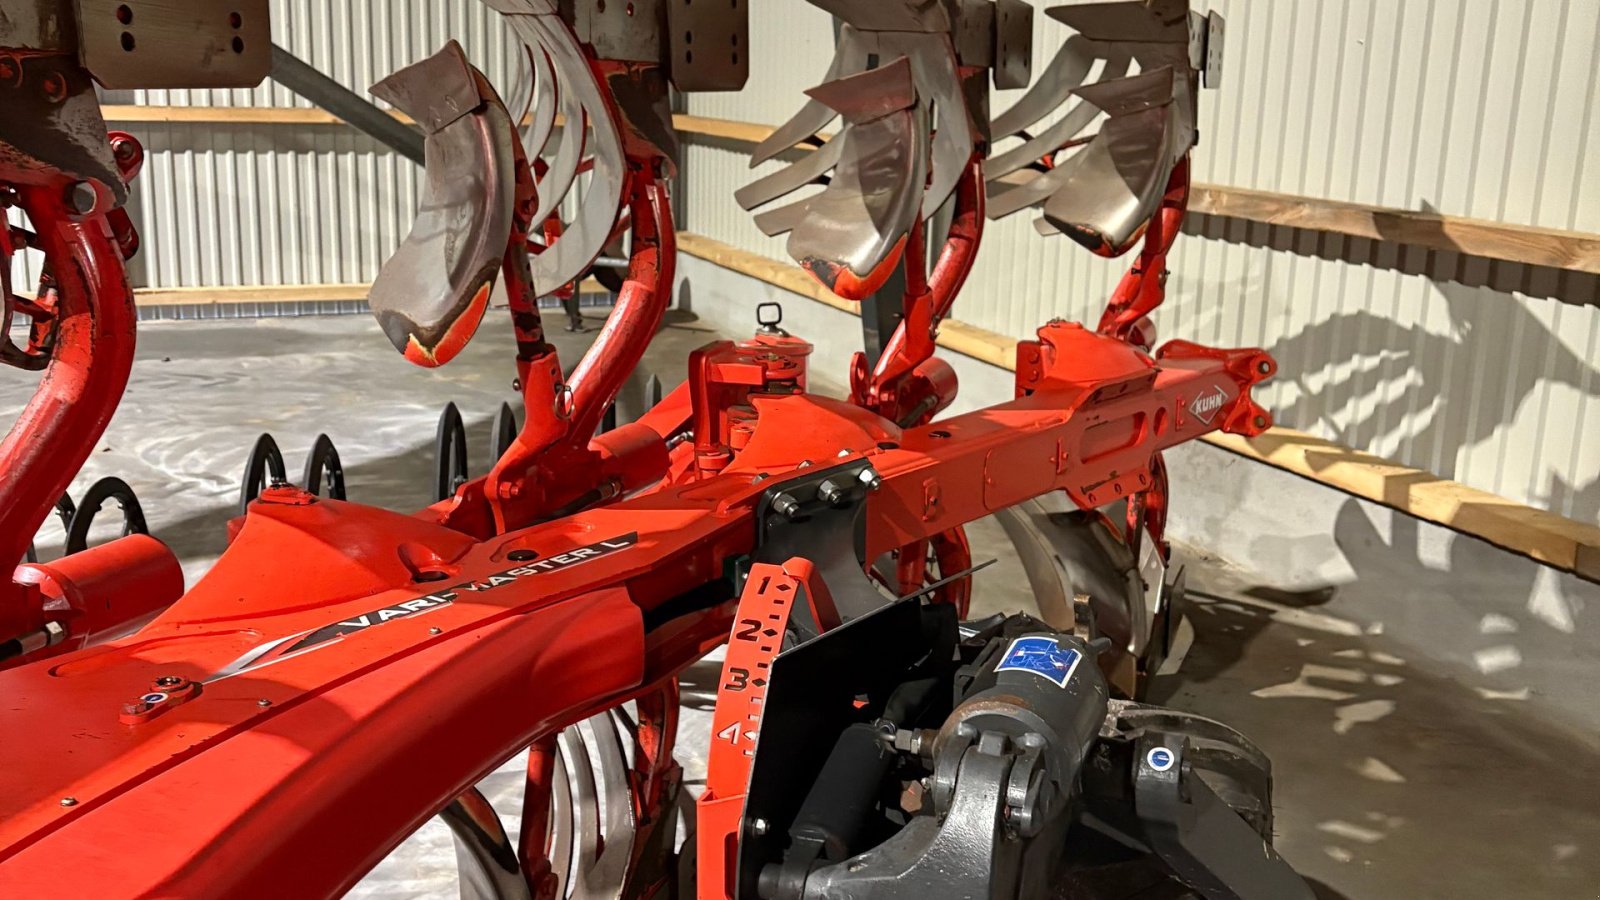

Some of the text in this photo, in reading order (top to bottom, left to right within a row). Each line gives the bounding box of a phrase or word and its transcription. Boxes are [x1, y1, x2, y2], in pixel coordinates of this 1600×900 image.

[1195, 393, 1222, 414] KUHN
[600, 541, 631, 549] L
[758, 576, 771, 595] 1
[736, 619, 763, 642] 2
[724, 667, 750, 691] 3
[717, 721, 742, 745] 4
